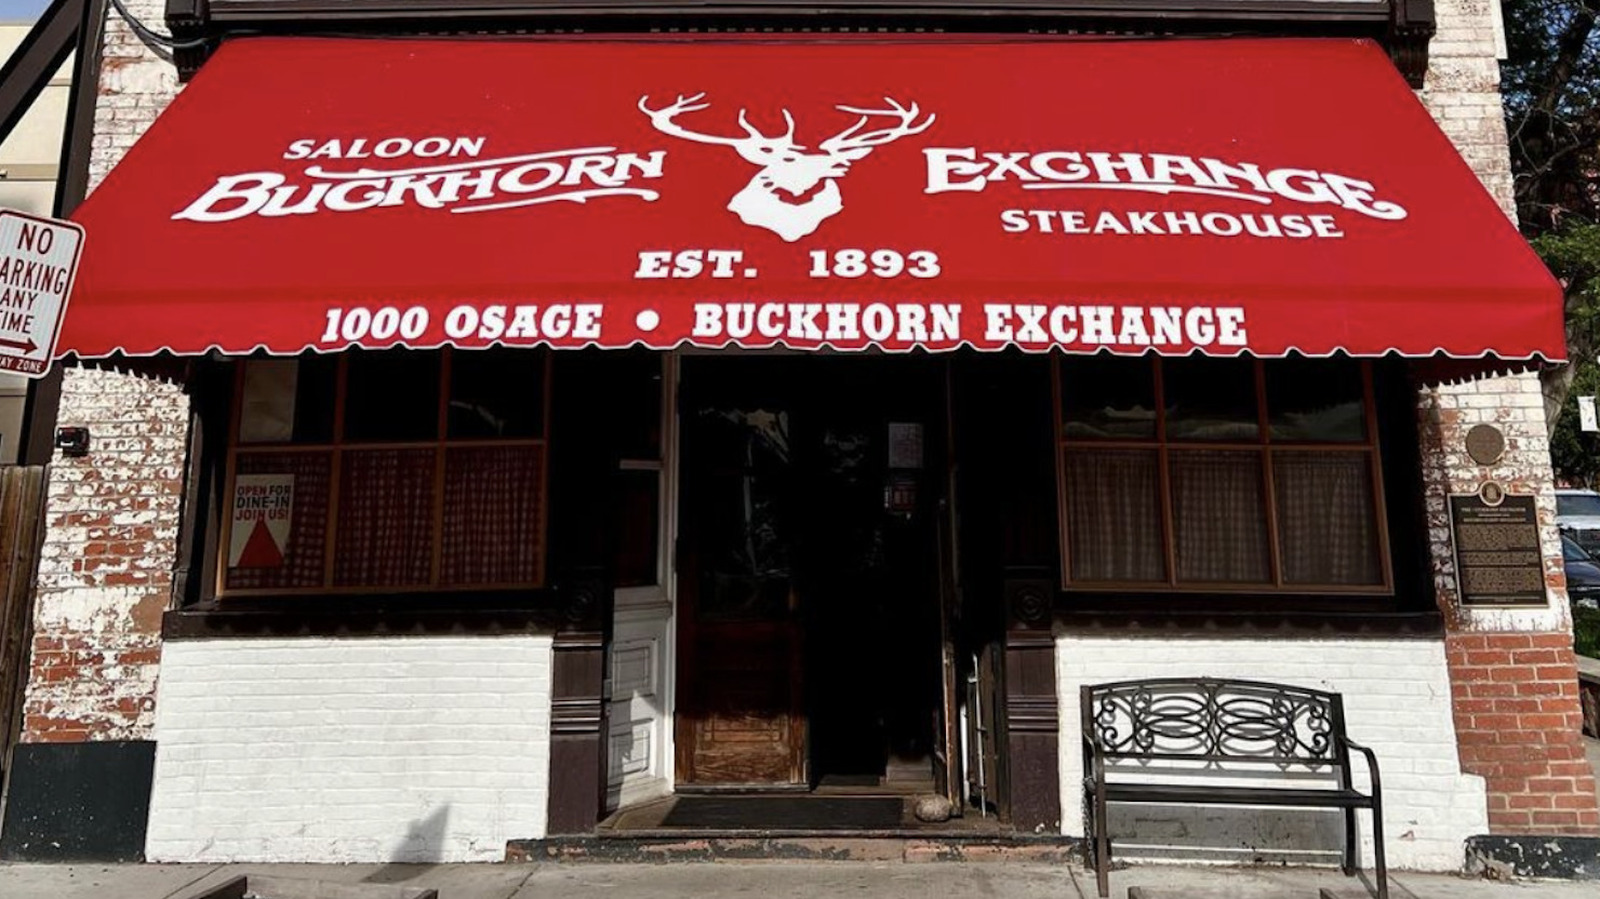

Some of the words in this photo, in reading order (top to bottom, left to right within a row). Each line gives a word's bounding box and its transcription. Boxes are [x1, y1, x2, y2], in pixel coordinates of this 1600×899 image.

[283, 137, 486, 160] SALOON
[1000, 208, 1345, 239] STEAKHOUSE
[17, 223, 53, 254] NO
[0, 256, 67, 295] ARKING
[634, 249, 758, 279] EST.
[809, 249, 941, 278] 1893
[0, 287, 38, 311] ANY
[0, 309, 35, 334] IME
[321, 306, 429, 342] 1000
[444, 304, 604, 339] OSAGE
[691, 302, 962, 341] BUCKHORN
[984, 304, 1248, 345] EXCHANGE
[0, 356, 13, 368] AY
[16, 359, 43, 374] ZONE
[236, 496, 290, 508] DINE-IN
[237, 485, 267, 496] OPEN
[269, 485, 291, 496] FOR
[235, 509, 266, 521] JOIN
[268, 509, 289, 520] US!
